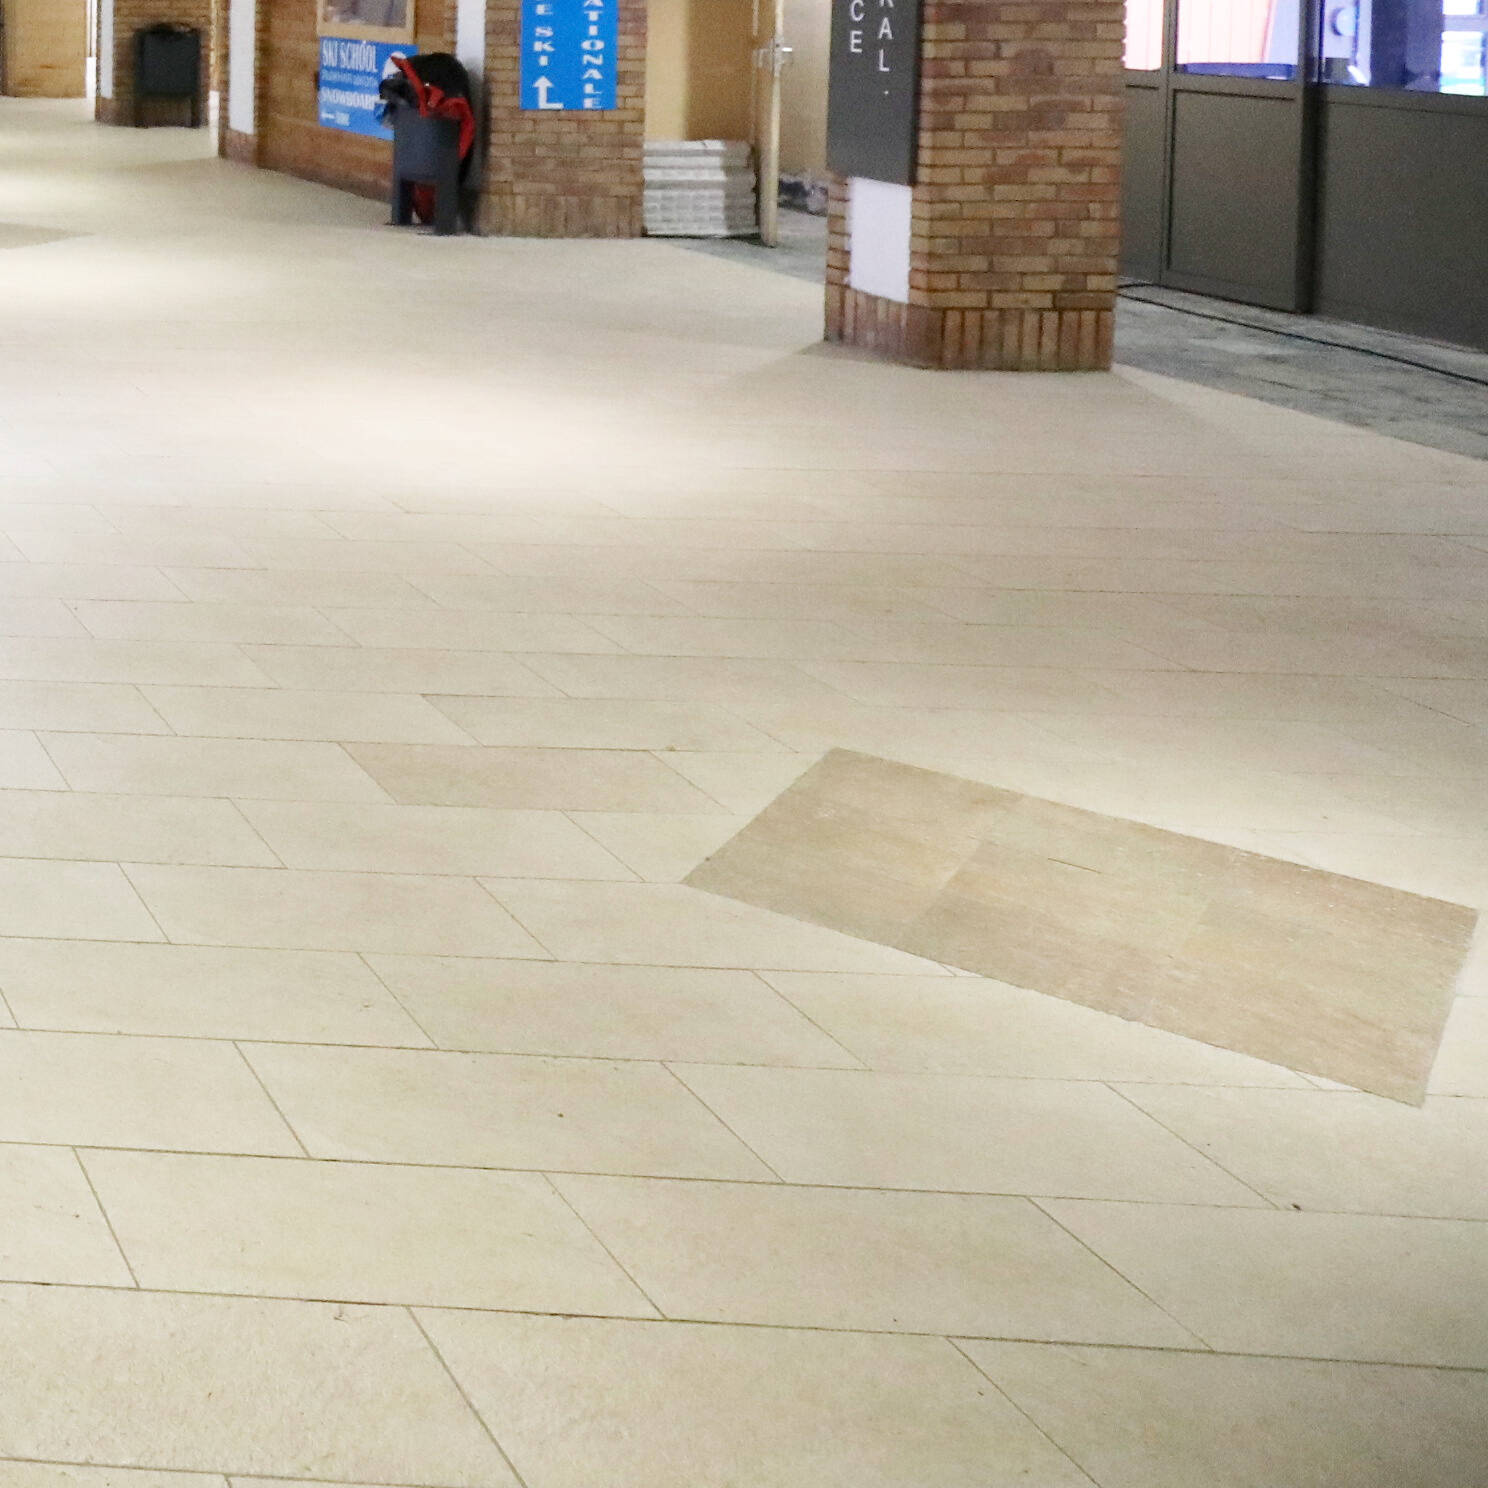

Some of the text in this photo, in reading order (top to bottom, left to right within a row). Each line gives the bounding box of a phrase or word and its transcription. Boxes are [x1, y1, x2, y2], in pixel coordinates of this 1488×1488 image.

[323, 40, 378, 72] SKI SCHOOL
[533, 26, 556, 66] SKI
